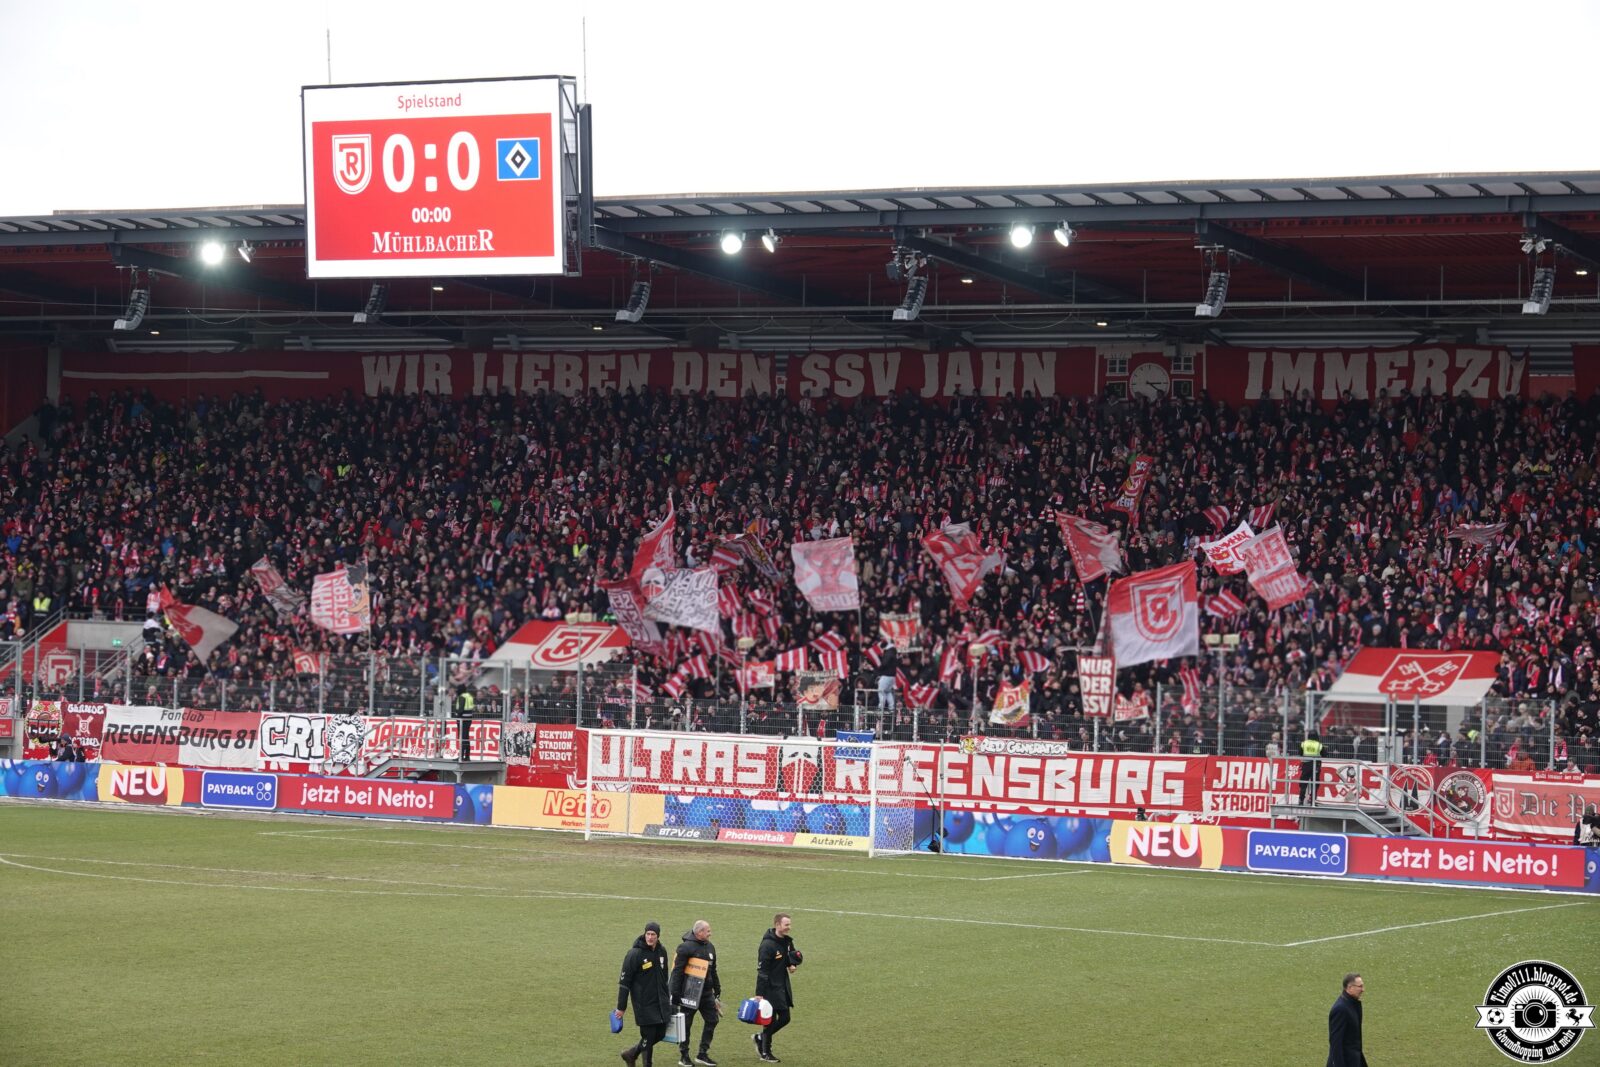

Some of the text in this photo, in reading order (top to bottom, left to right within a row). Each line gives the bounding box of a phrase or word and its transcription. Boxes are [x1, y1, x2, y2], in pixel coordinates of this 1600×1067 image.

[397, 93, 462, 112] Spielstand
[382, 131, 480, 193] 0:0
[411, 207, 451, 223] 00:00
[371, 229, 495, 254] MÜHLBACHER
[361, 353, 452, 396] WIR
[473, 352, 651, 396] LIEBEN
[671, 350, 772, 398] DEN
[800, 351, 902, 398] SSV
[920, 350, 1057, 398] JAHN
[1080, 658, 1112, 675] NUR
[1080, 675, 1111, 694] DER
[1083, 694, 1110, 714] SSV
[160, 709, 205, 723] Fanclub
[105, 723, 231, 750] REGENSBURG
[233, 729, 257, 750] 81
[539, 729, 574, 740] SEKTION
[539, 740, 573, 750] STADION
[539, 750, 573, 761] VERBOT
[591, 735, 1187, 807] ULTRAS REGENSBURG
[1212, 761, 1279, 791] JAHN
[109, 766, 166, 797] NEU
[207, 783, 254, 796] PAYBACK
[301, 782, 435, 809] jetzt bei Netto!
[1519, 791, 1559, 817] Die
[658, 827, 700, 839] BTPV.de
[724, 831, 785, 843] Photovoltaik
[810, 836, 854, 847] Autarkie
[1126, 824, 1200, 858] NEU
[1255, 844, 1317, 859] PAYBACK
[1380, 845, 1558, 877] jetzt bei Netto!
